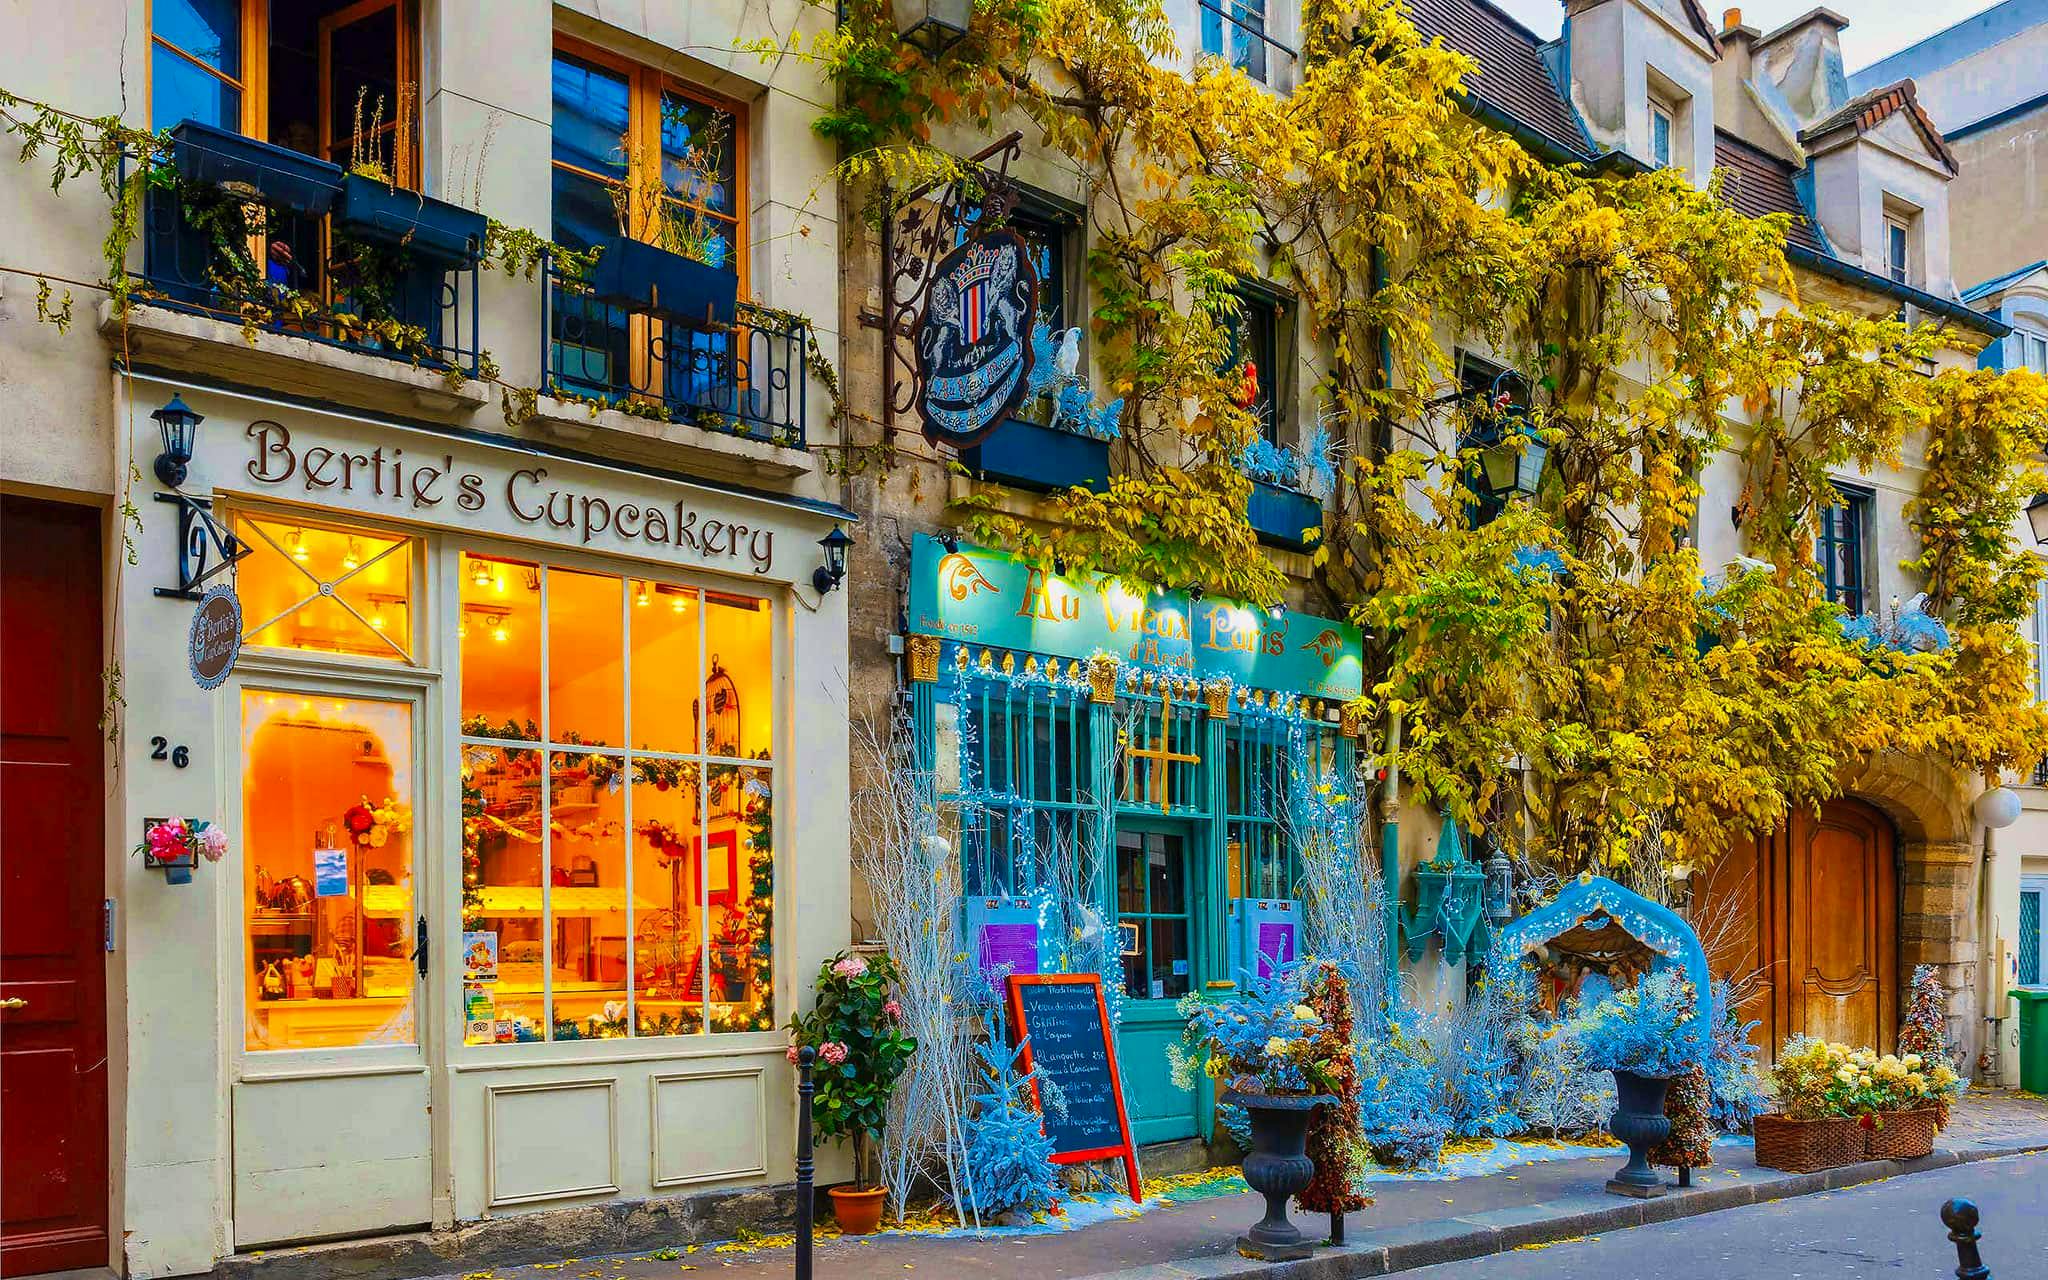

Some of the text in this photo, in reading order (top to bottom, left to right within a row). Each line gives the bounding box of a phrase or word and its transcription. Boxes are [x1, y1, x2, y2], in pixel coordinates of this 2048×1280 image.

[247, 419, 774, 574] Bertie's Cupcakery
[1016, 564, 1080, 622] Au
[150, 735, 190, 769] 26
